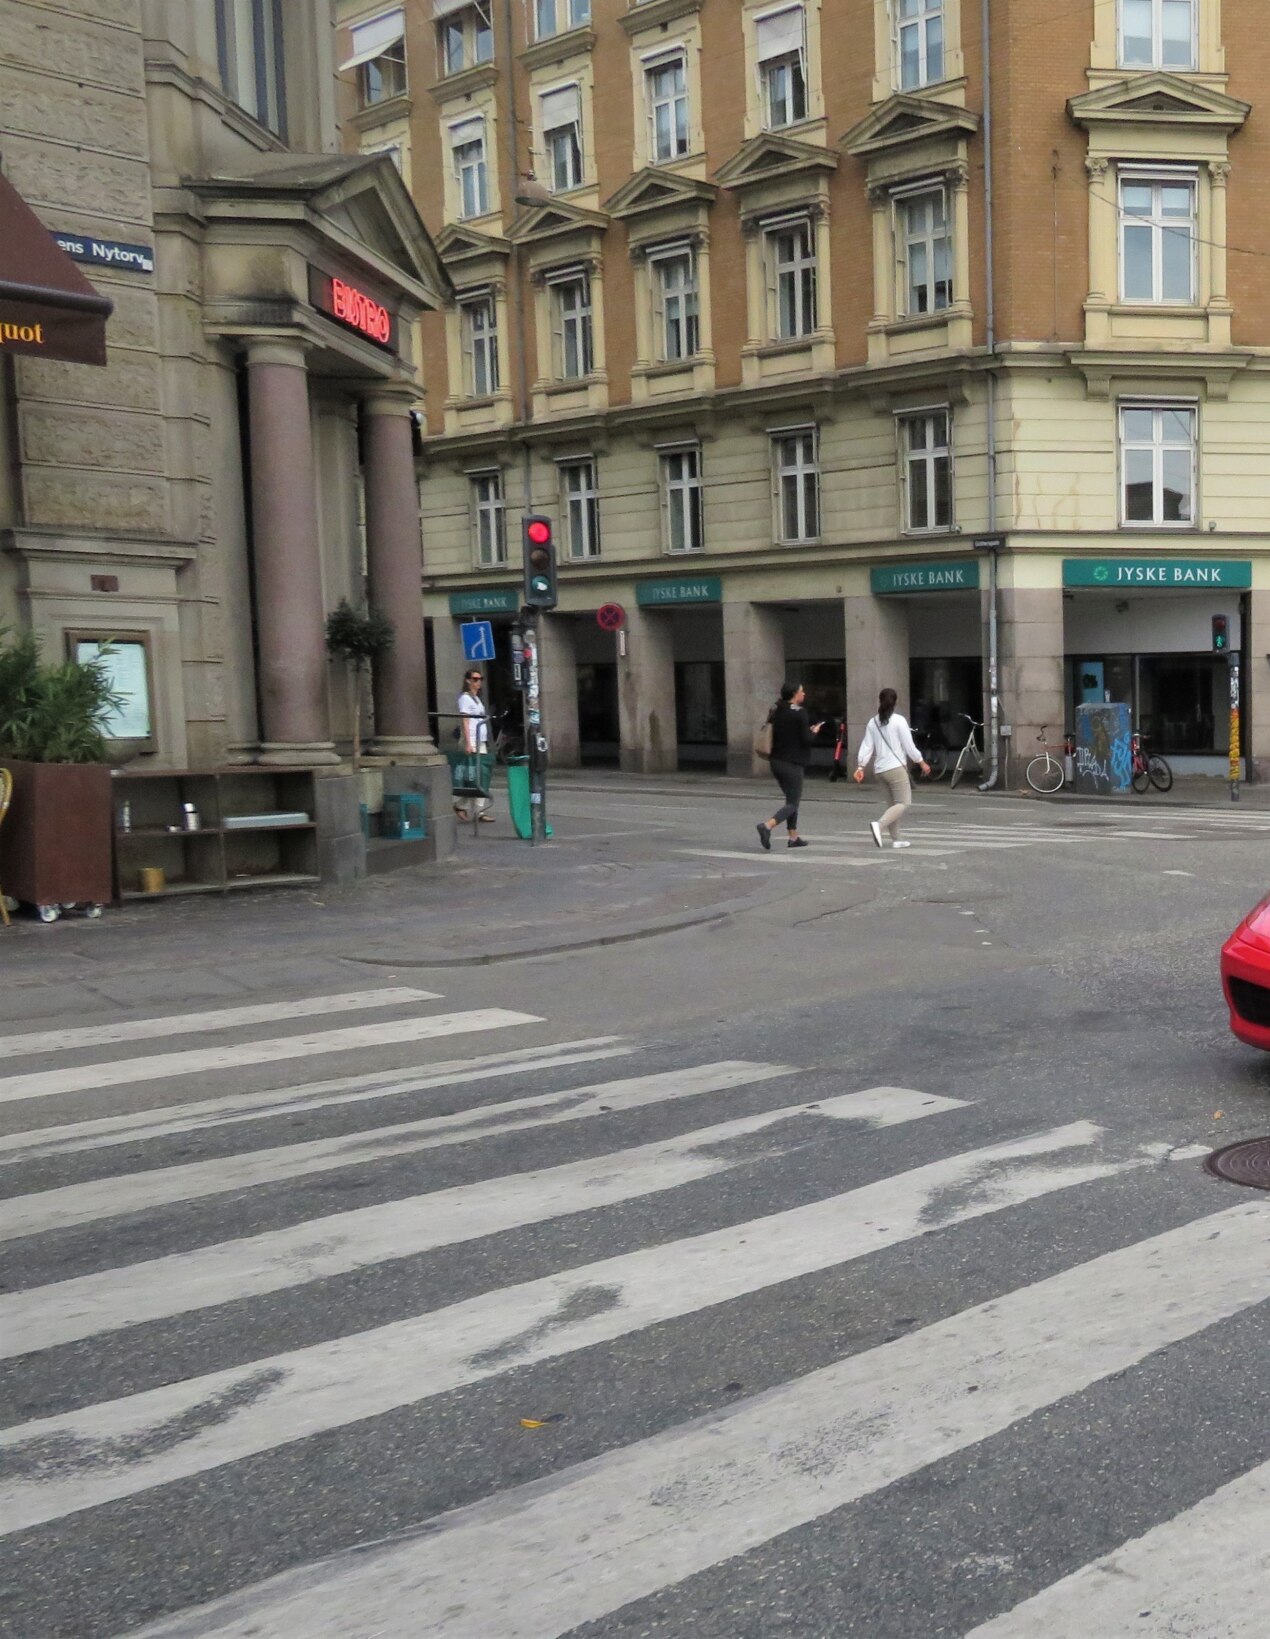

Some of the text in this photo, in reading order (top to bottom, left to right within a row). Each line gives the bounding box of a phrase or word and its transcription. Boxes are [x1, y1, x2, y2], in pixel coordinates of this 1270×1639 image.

[92, 243, 145, 263] Nytorv
[893, 569, 965, 587] JYSKE BANK
[1117, 567, 1222, 582] JYSKE BANK
[679, 585, 709, 598] BANK
